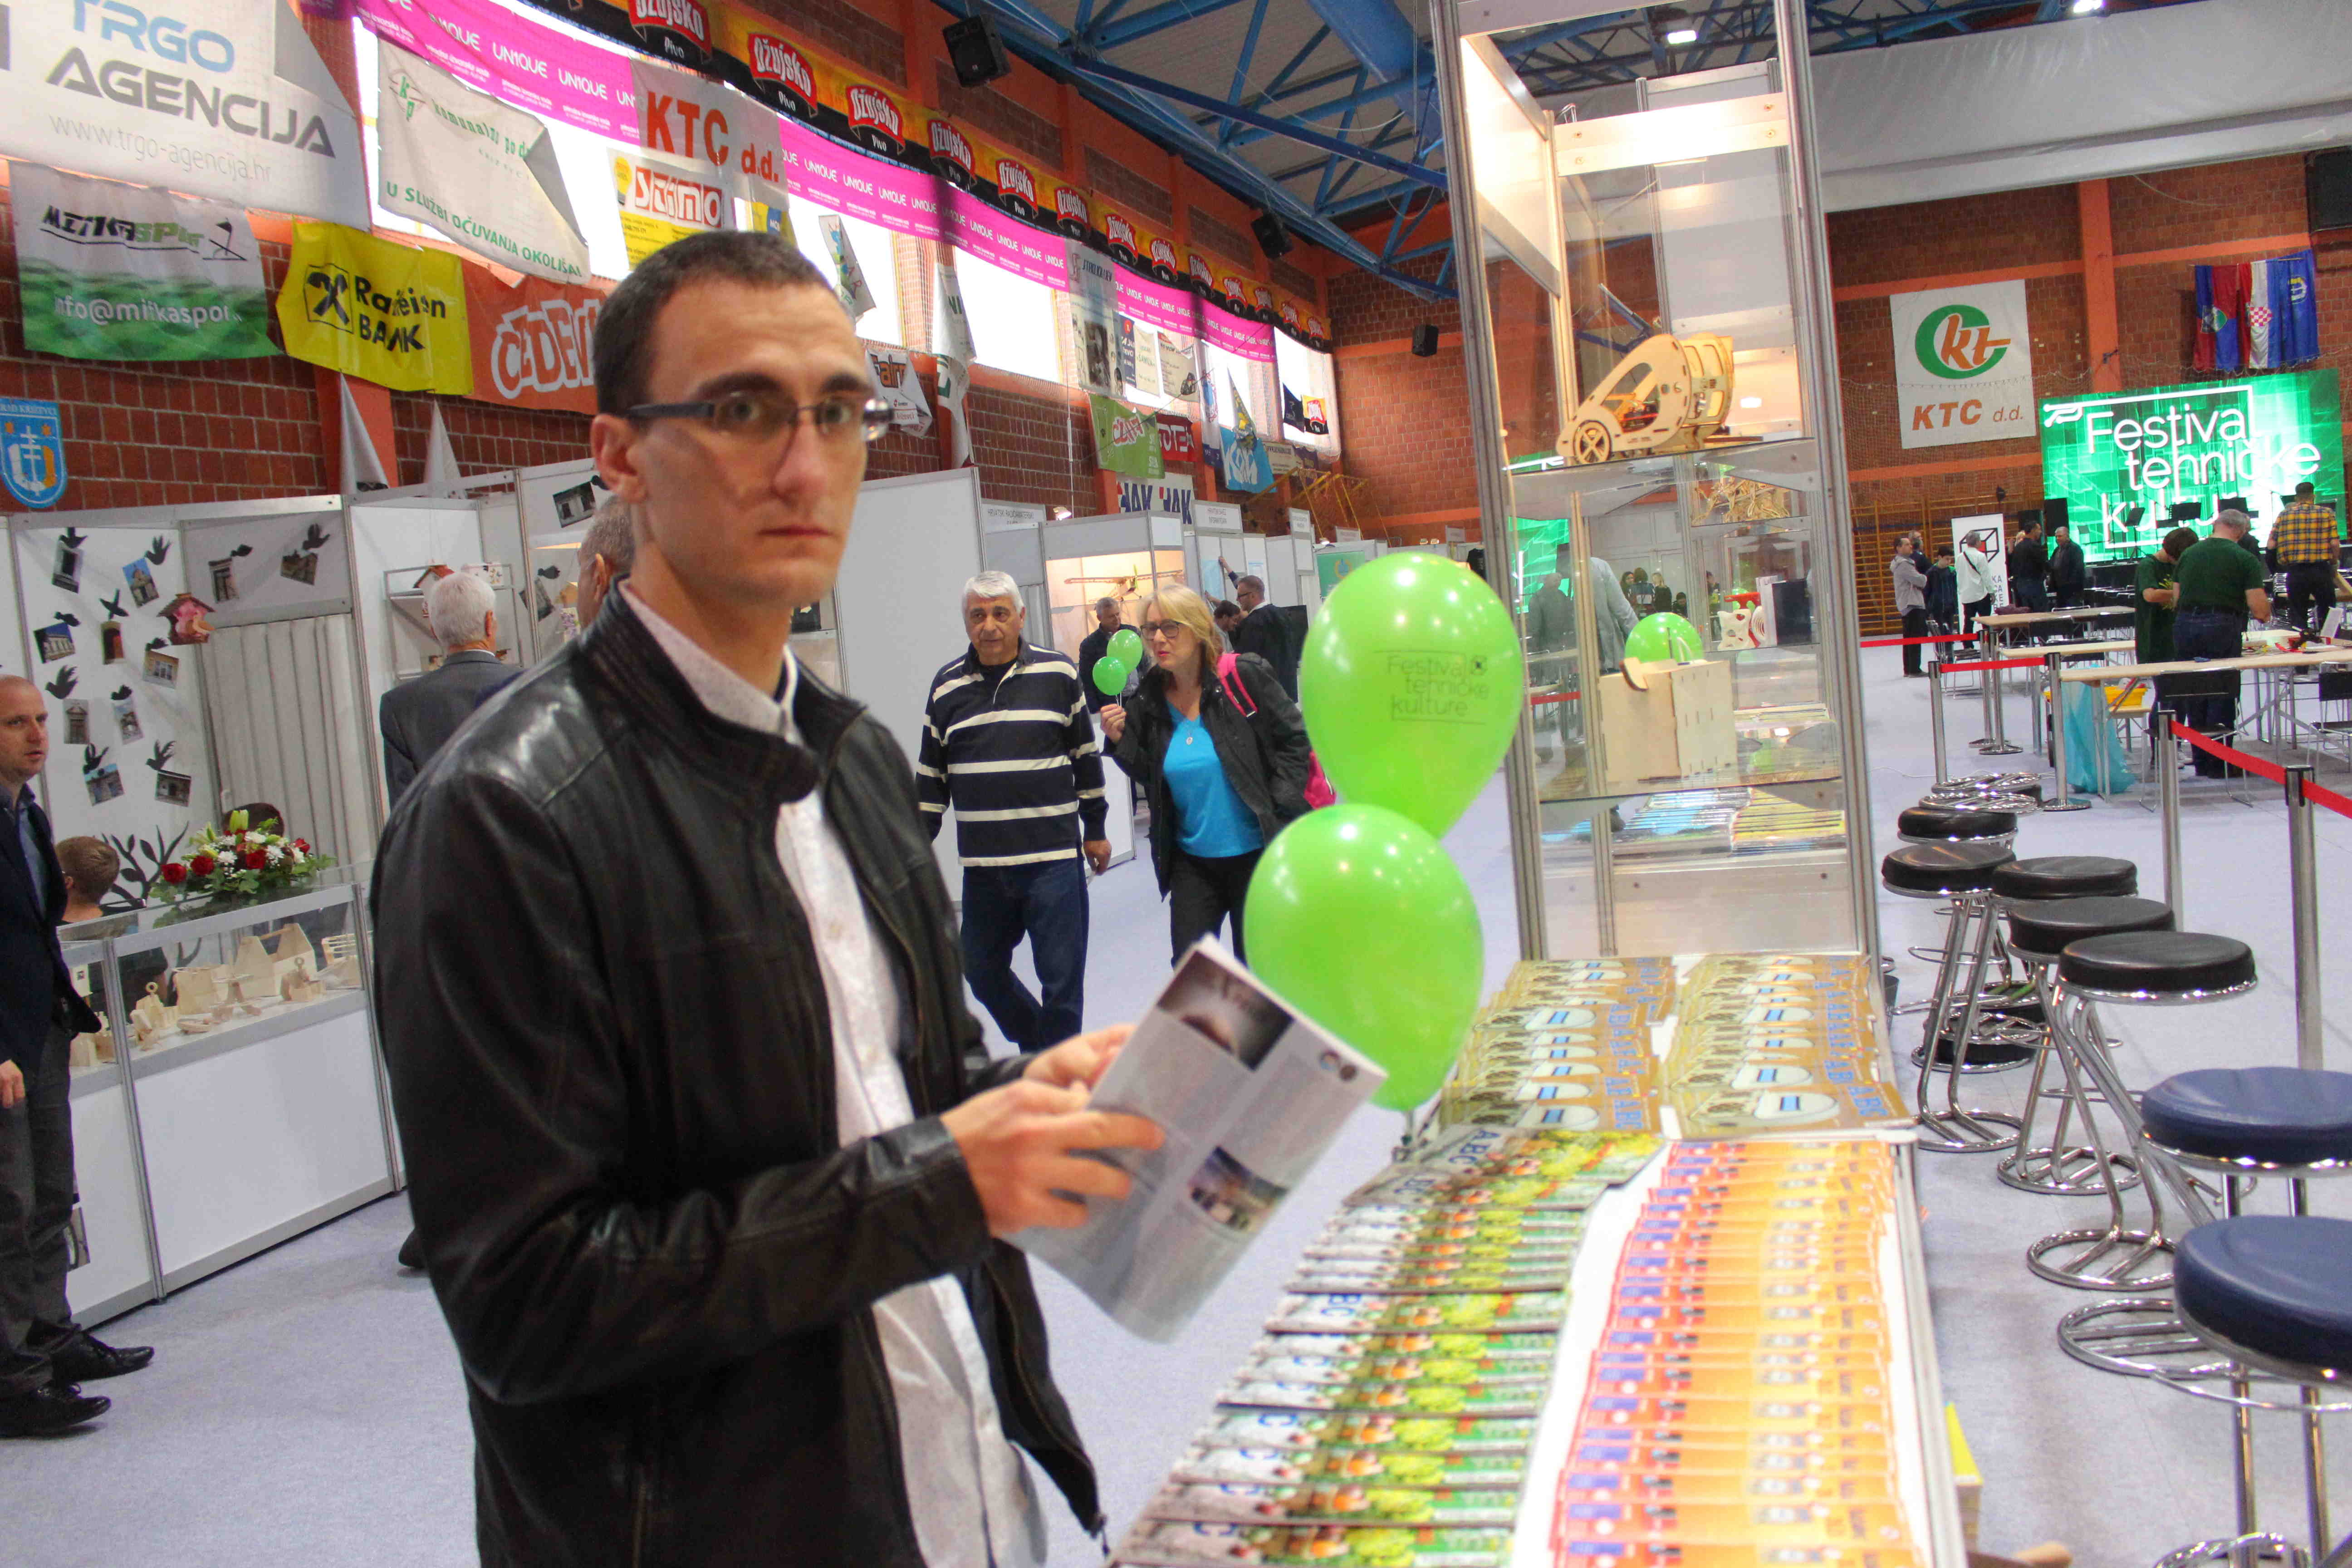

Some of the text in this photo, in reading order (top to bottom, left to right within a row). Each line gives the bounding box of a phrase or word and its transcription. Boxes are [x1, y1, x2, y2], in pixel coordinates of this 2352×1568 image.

[74, 0, 235, 73] TRGO
[754, 37, 812, 97] Ožujsko
[46, 47, 335, 158] AGENCIJA
[778, 90, 796, 112] Pivo
[850, 88, 899, 136] Ožujsko
[49, 113, 271, 182] www.trgo-agencija.hr
[647, 91, 729, 166] KTC
[740, 143, 779, 182] d.d.
[387, 181, 398, 197] U
[405, 187, 449, 223] SLUŽBI
[452, 214, 519, 258] OČUVANJA
[1912, 399, 2024, 431] KTC d.d.
[2087, 392, 2262, 454] Festival
[2125, 437, 2321, 491] tehničke
[1387, 654, 1467, 676] Festival
[1390, 693, 1468, 717] kulture
